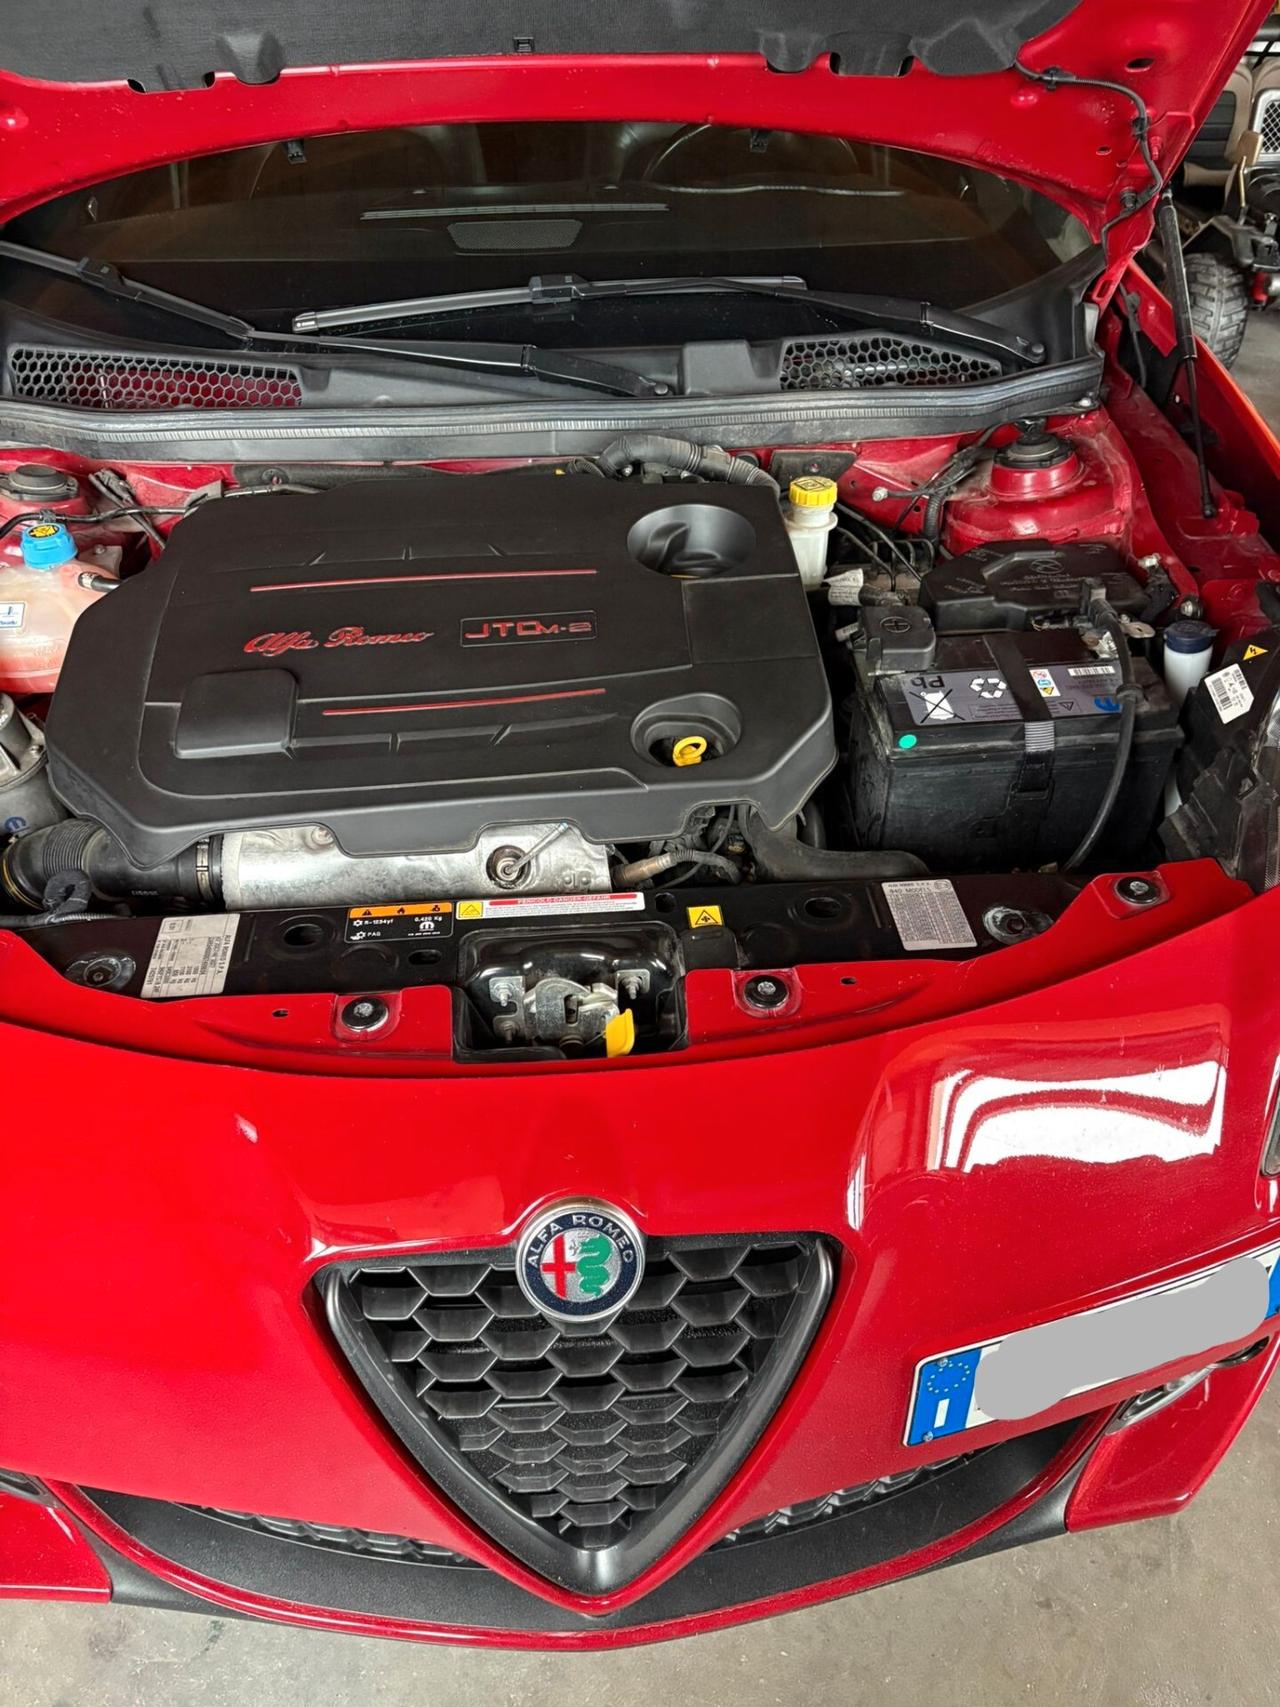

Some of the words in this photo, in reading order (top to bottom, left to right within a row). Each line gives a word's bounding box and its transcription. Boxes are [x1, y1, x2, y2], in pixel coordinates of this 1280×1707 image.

[243, 631, 319, 658] Alfa
[323, 626, 436, 649] Romeo
[527, 1222, 563, 1267] ALFA
[572, 1215, 634, 1263] ROMEO
